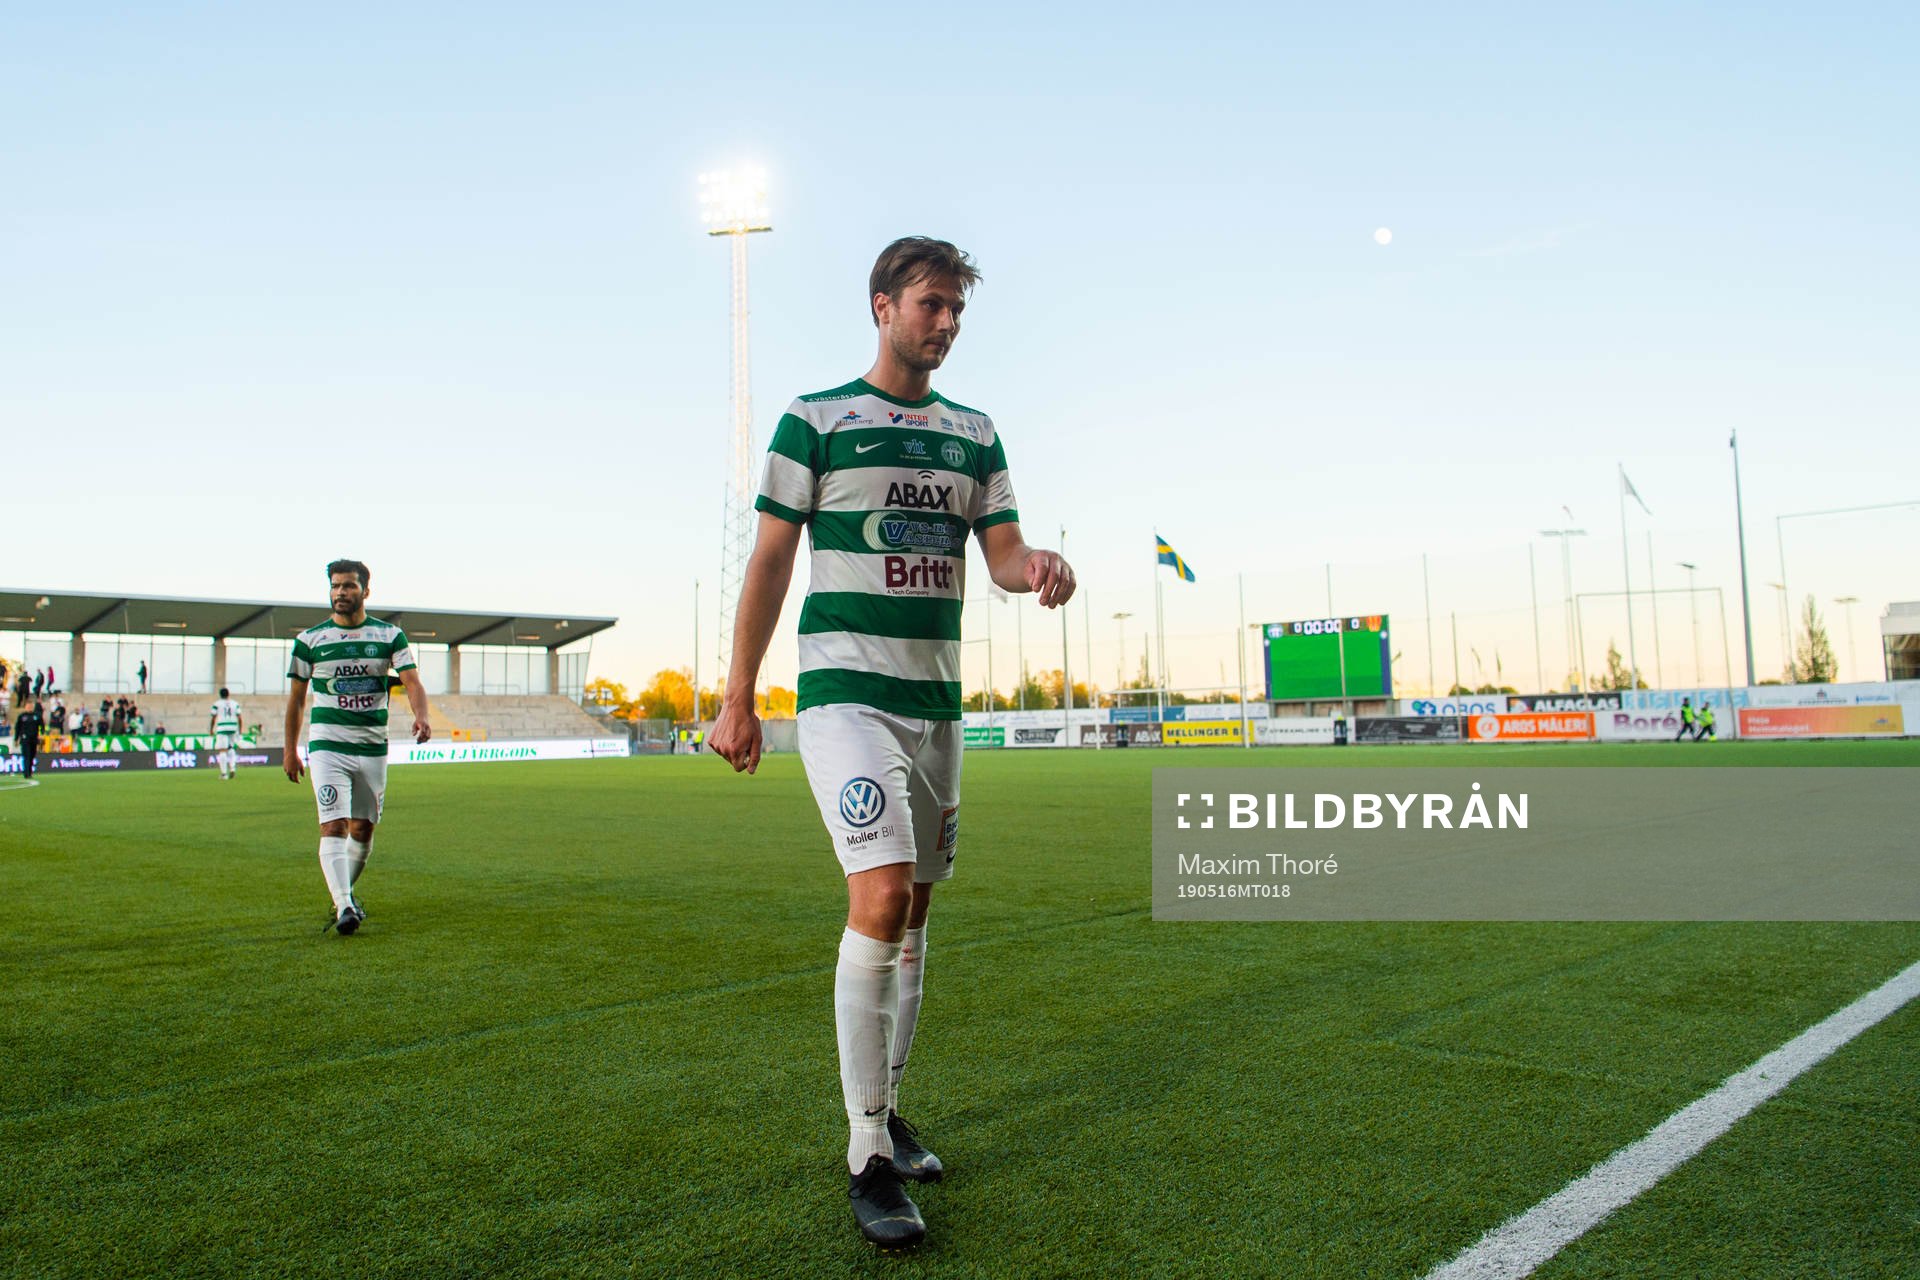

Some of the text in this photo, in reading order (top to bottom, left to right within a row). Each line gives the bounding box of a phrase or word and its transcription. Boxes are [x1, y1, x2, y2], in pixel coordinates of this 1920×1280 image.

[904, 413, 928, 422] INTER
[905, 420, 929, 428] SPORT
[884, 482, 953, 511] ABAX
[885, 556, 953, 589] Britt
[334, 665, 369, 678] ABAX
[338, 696, 374, 709] Britt
[1534, 697, 1620, 712] ALFAGLAS
[1167, 727, 1229, 738] MELLINGER
[1502, 720, 1536, 734] AROS
[51, 759, 59, 769] A
[60, 758, 79, 768] Tech
[81, 757, 120, 770] Company
[155, 751, 197, 769] Britt
[881, 825, 895, 838] Bil
